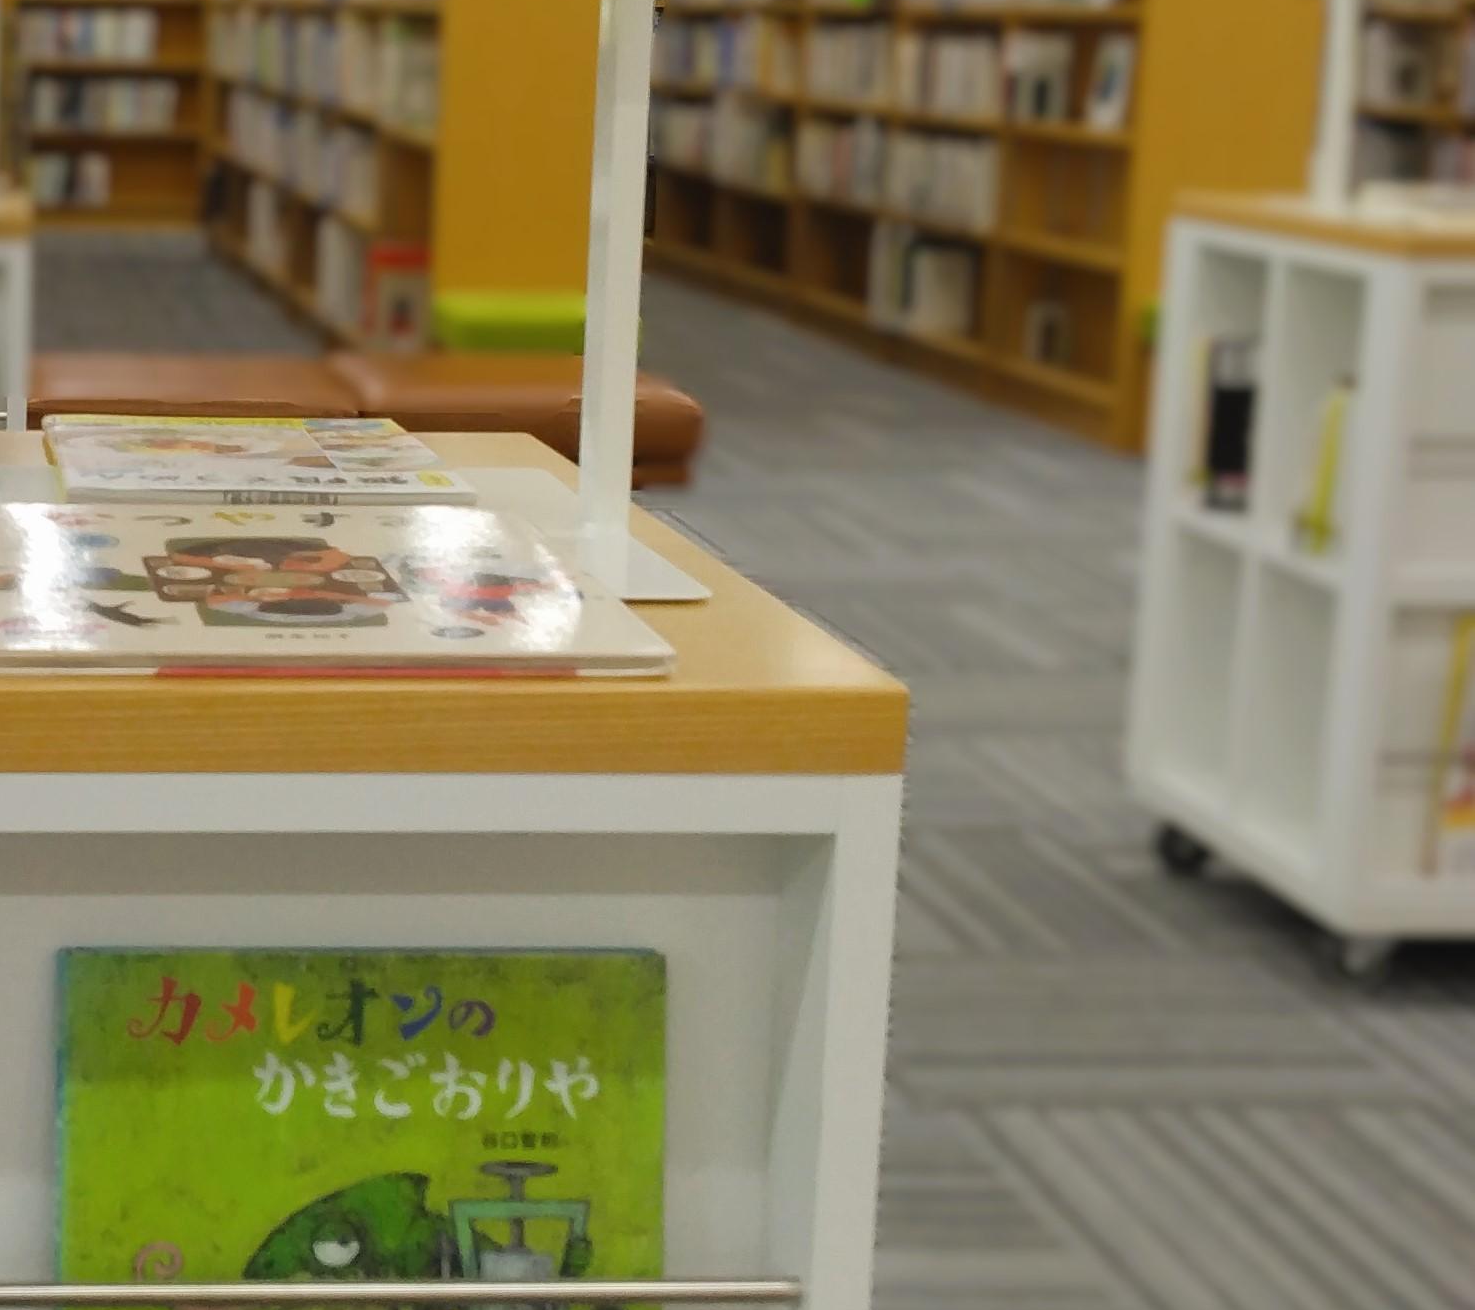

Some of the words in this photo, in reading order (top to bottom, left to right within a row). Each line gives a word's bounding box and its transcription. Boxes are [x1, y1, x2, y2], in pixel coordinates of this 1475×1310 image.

[125, 975, 496, 1048] カメレオンの
[253, 1051, 601, 1120] かきごおりや
